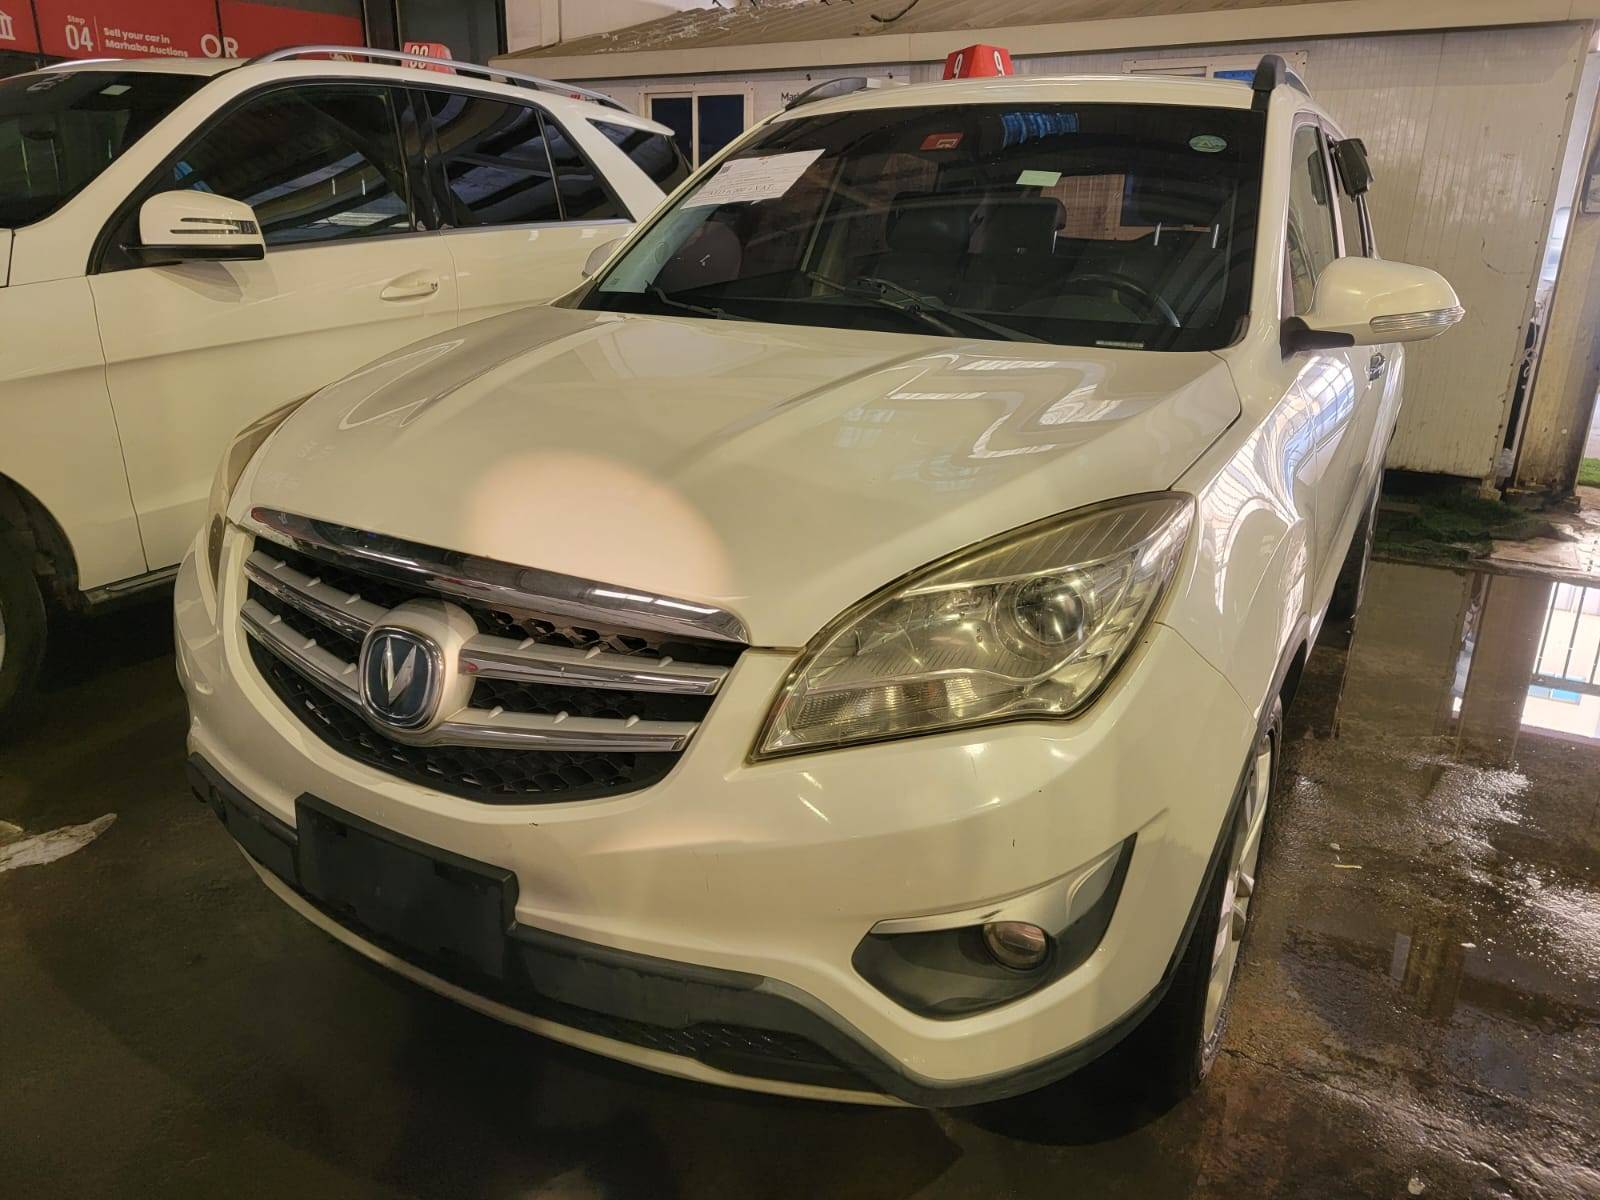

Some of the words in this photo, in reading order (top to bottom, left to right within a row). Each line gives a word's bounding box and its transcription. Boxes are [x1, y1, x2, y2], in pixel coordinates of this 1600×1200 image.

[67, 15, 85, 26] Step
[65, 24, 93, 52] 04
[103, 27, 121, 38] Sell
[122, 31, 143, 40] your
[145, 34, 160, 42] car
[161, 34, 170, 44] in
[200, 34, 239, 58] OR
[105, 39, 148, 52] Marhaba
[149, 45, 188, 58] Auctions
[993, 50, 1005, 77] 9
